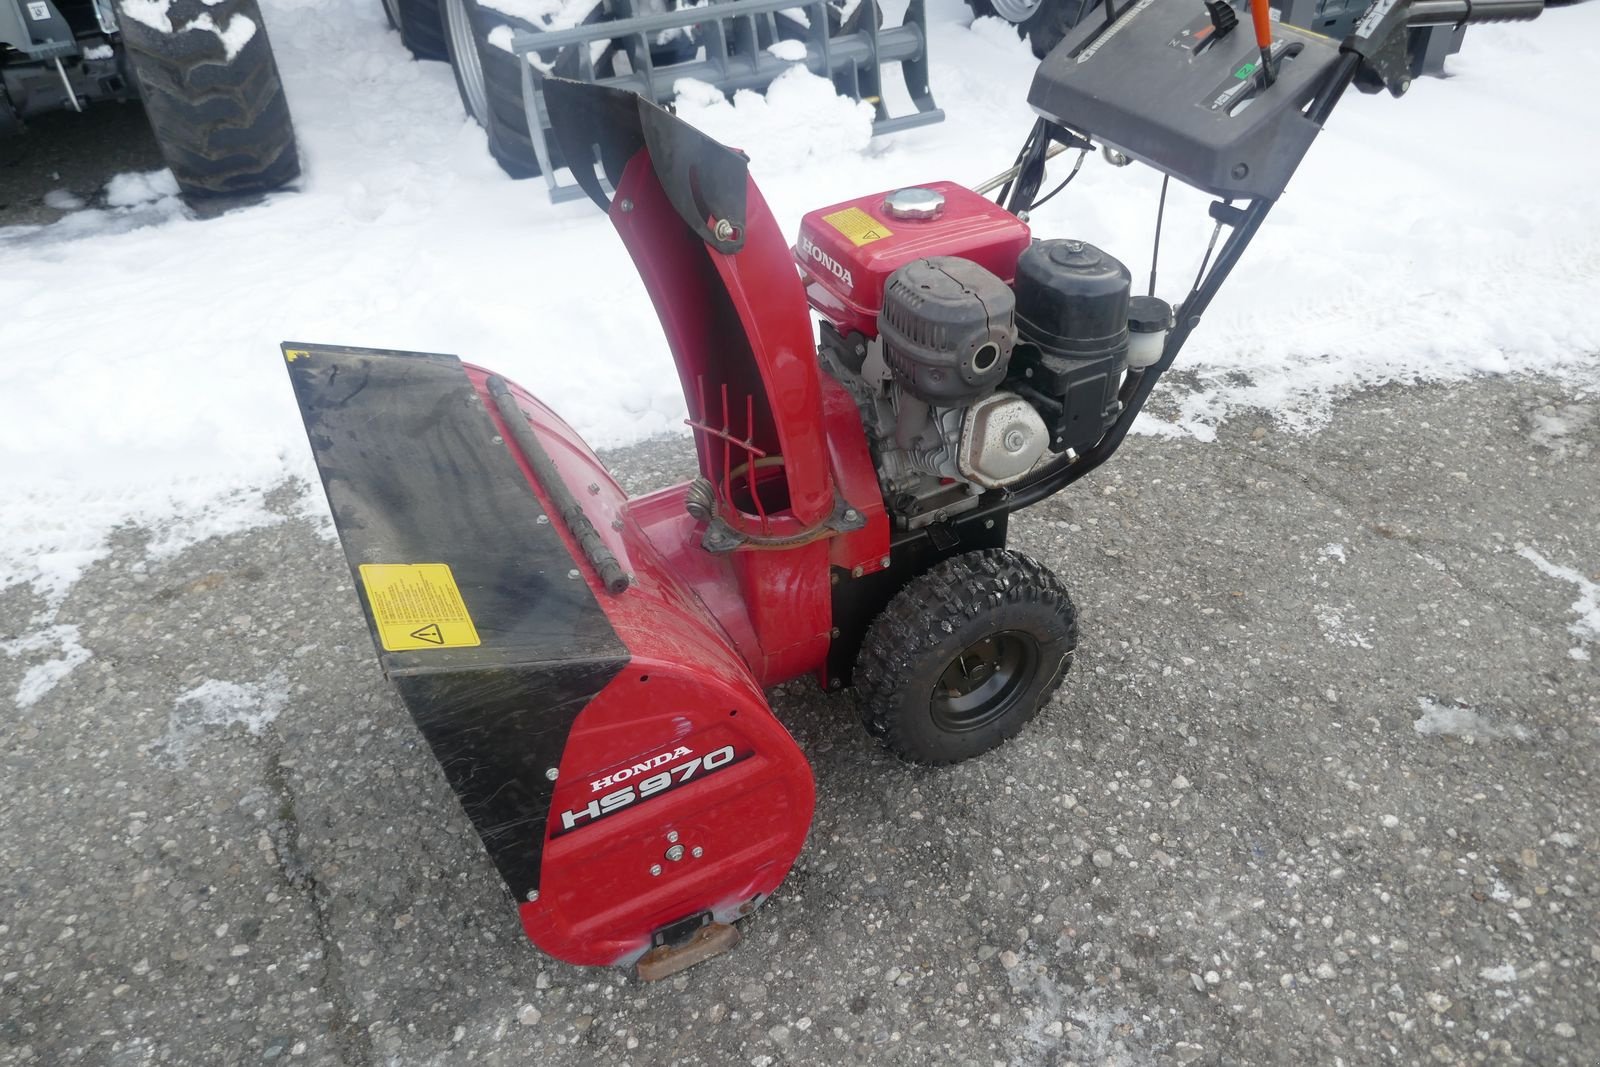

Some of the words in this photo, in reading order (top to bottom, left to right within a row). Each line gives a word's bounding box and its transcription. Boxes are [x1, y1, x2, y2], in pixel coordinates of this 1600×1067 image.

[802, 237, 854, 289] HONDA
[561, 745, 735, 829] HS970
[590, 745, 693, 793] HONDA
